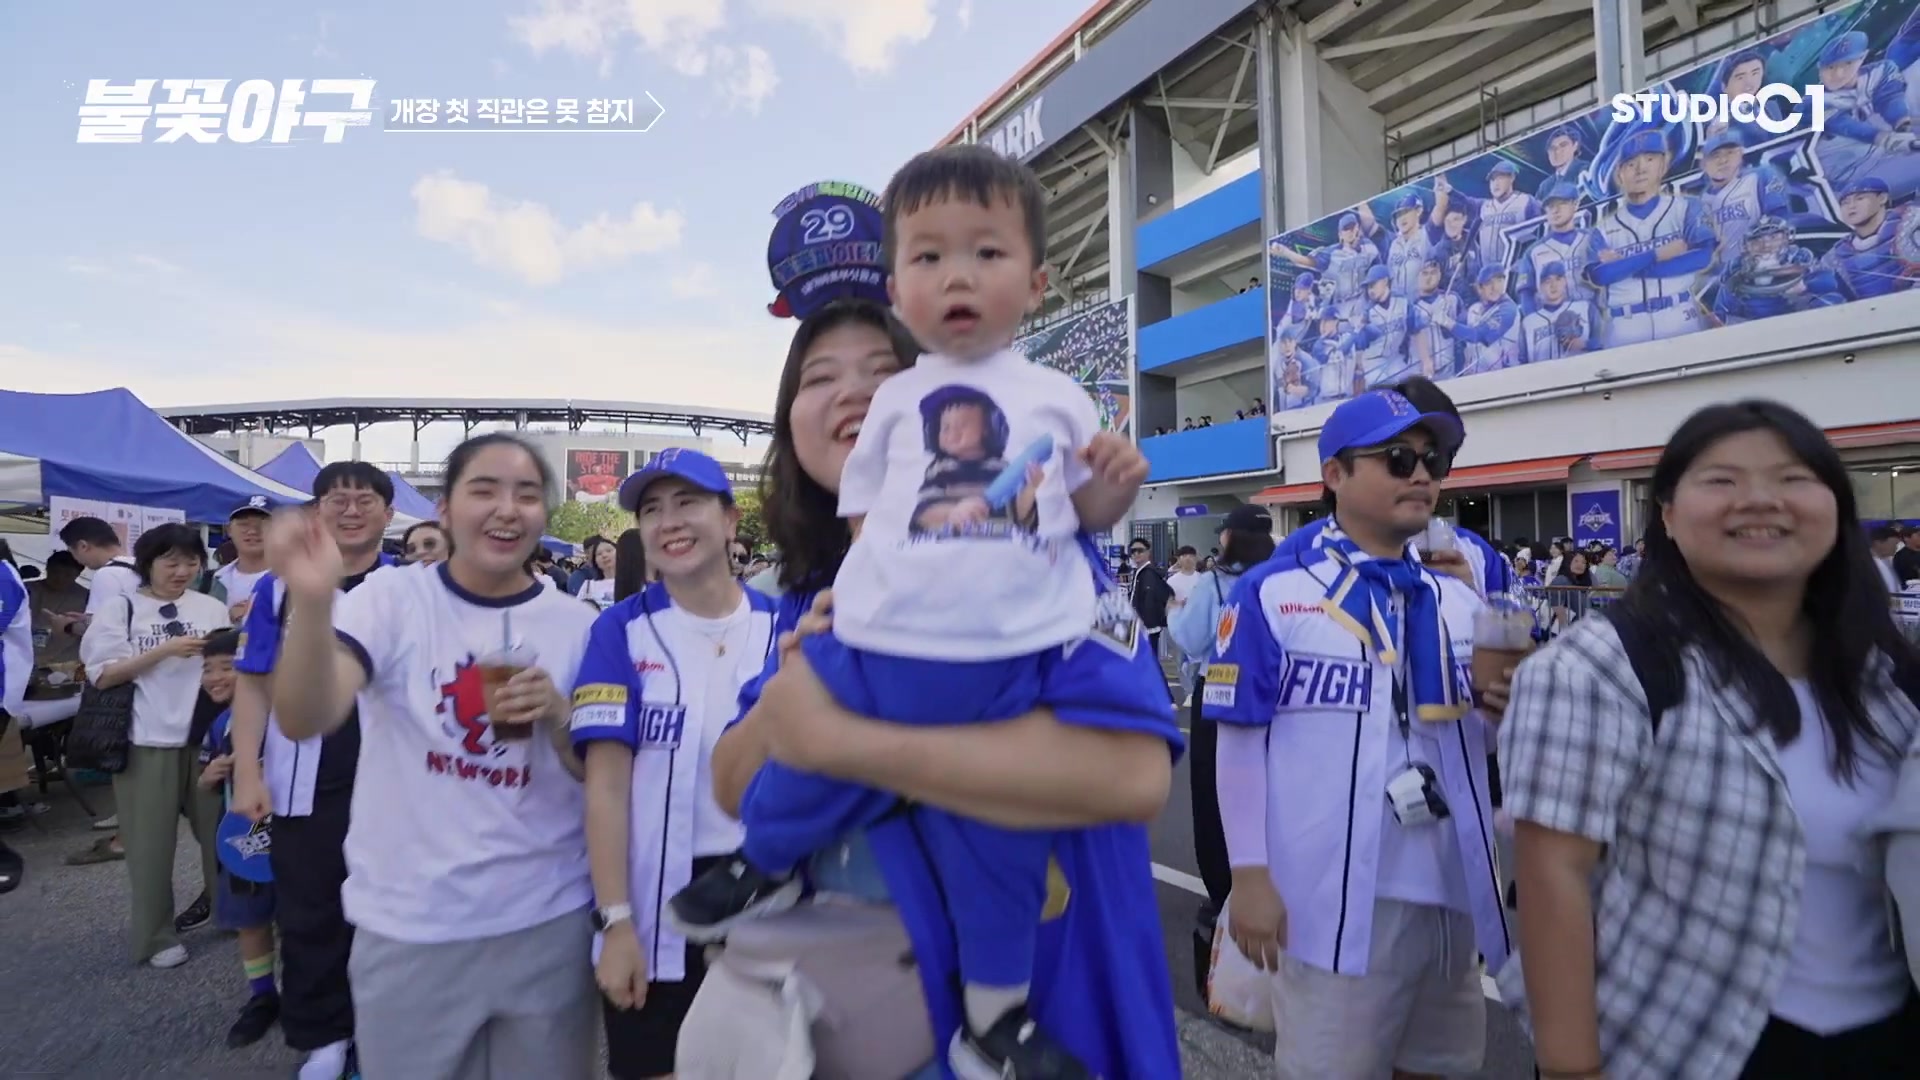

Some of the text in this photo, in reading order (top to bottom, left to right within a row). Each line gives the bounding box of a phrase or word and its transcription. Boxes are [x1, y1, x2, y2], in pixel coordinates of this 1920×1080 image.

[985, 96, 1046, 161] ARK
[801, 204, 855, 245] 29
[600, 453, 621, 464] THE
[1280, 603, 1325, 614] Wilson
[1280, 659, 1370, 706] FIGH
